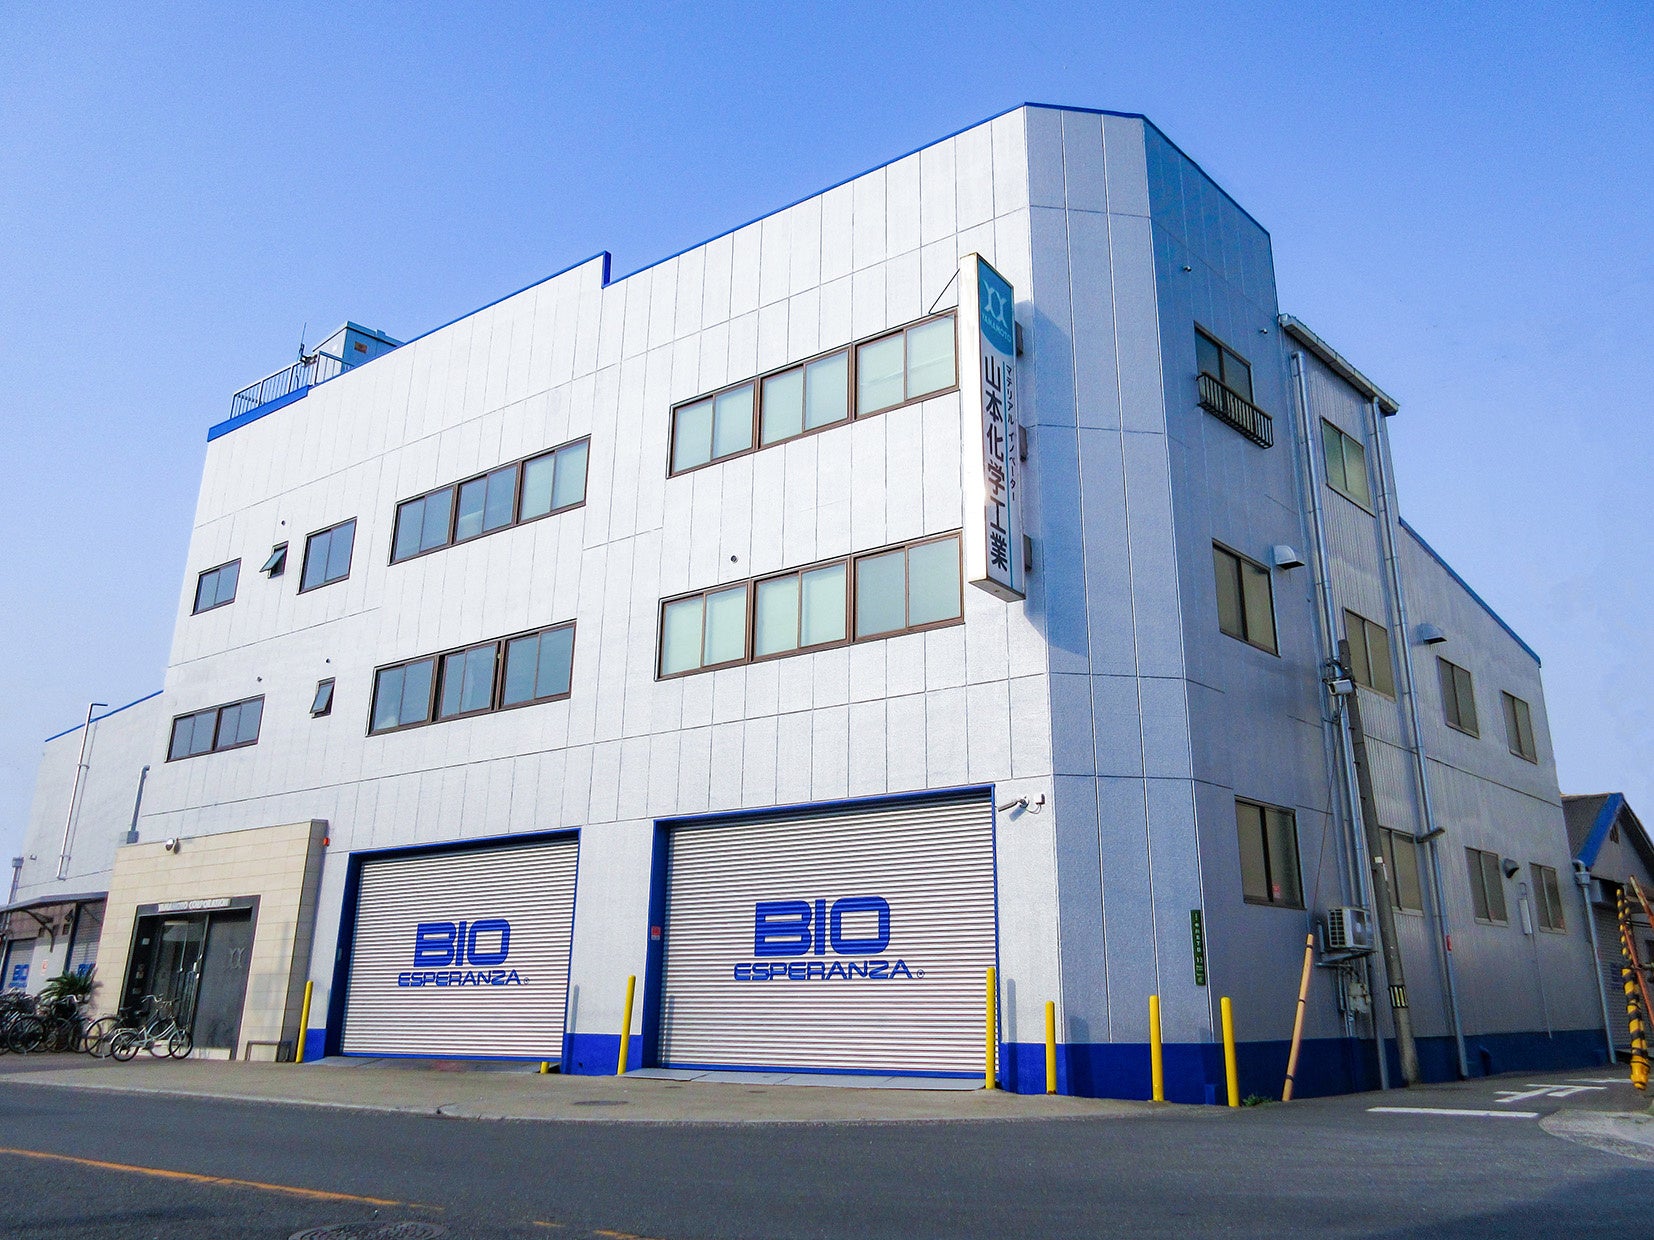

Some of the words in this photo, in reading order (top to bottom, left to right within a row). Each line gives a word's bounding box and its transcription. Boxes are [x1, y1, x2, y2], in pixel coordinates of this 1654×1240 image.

[984, 355, 1009, 572] 山本化学工業
[413, 918, 511, 968] BIO
[754, 895, 891, 957] BIO
[398, 969, 521, 987] ESPERANZA
[733, 959, 913, 981] ESPERANZA
